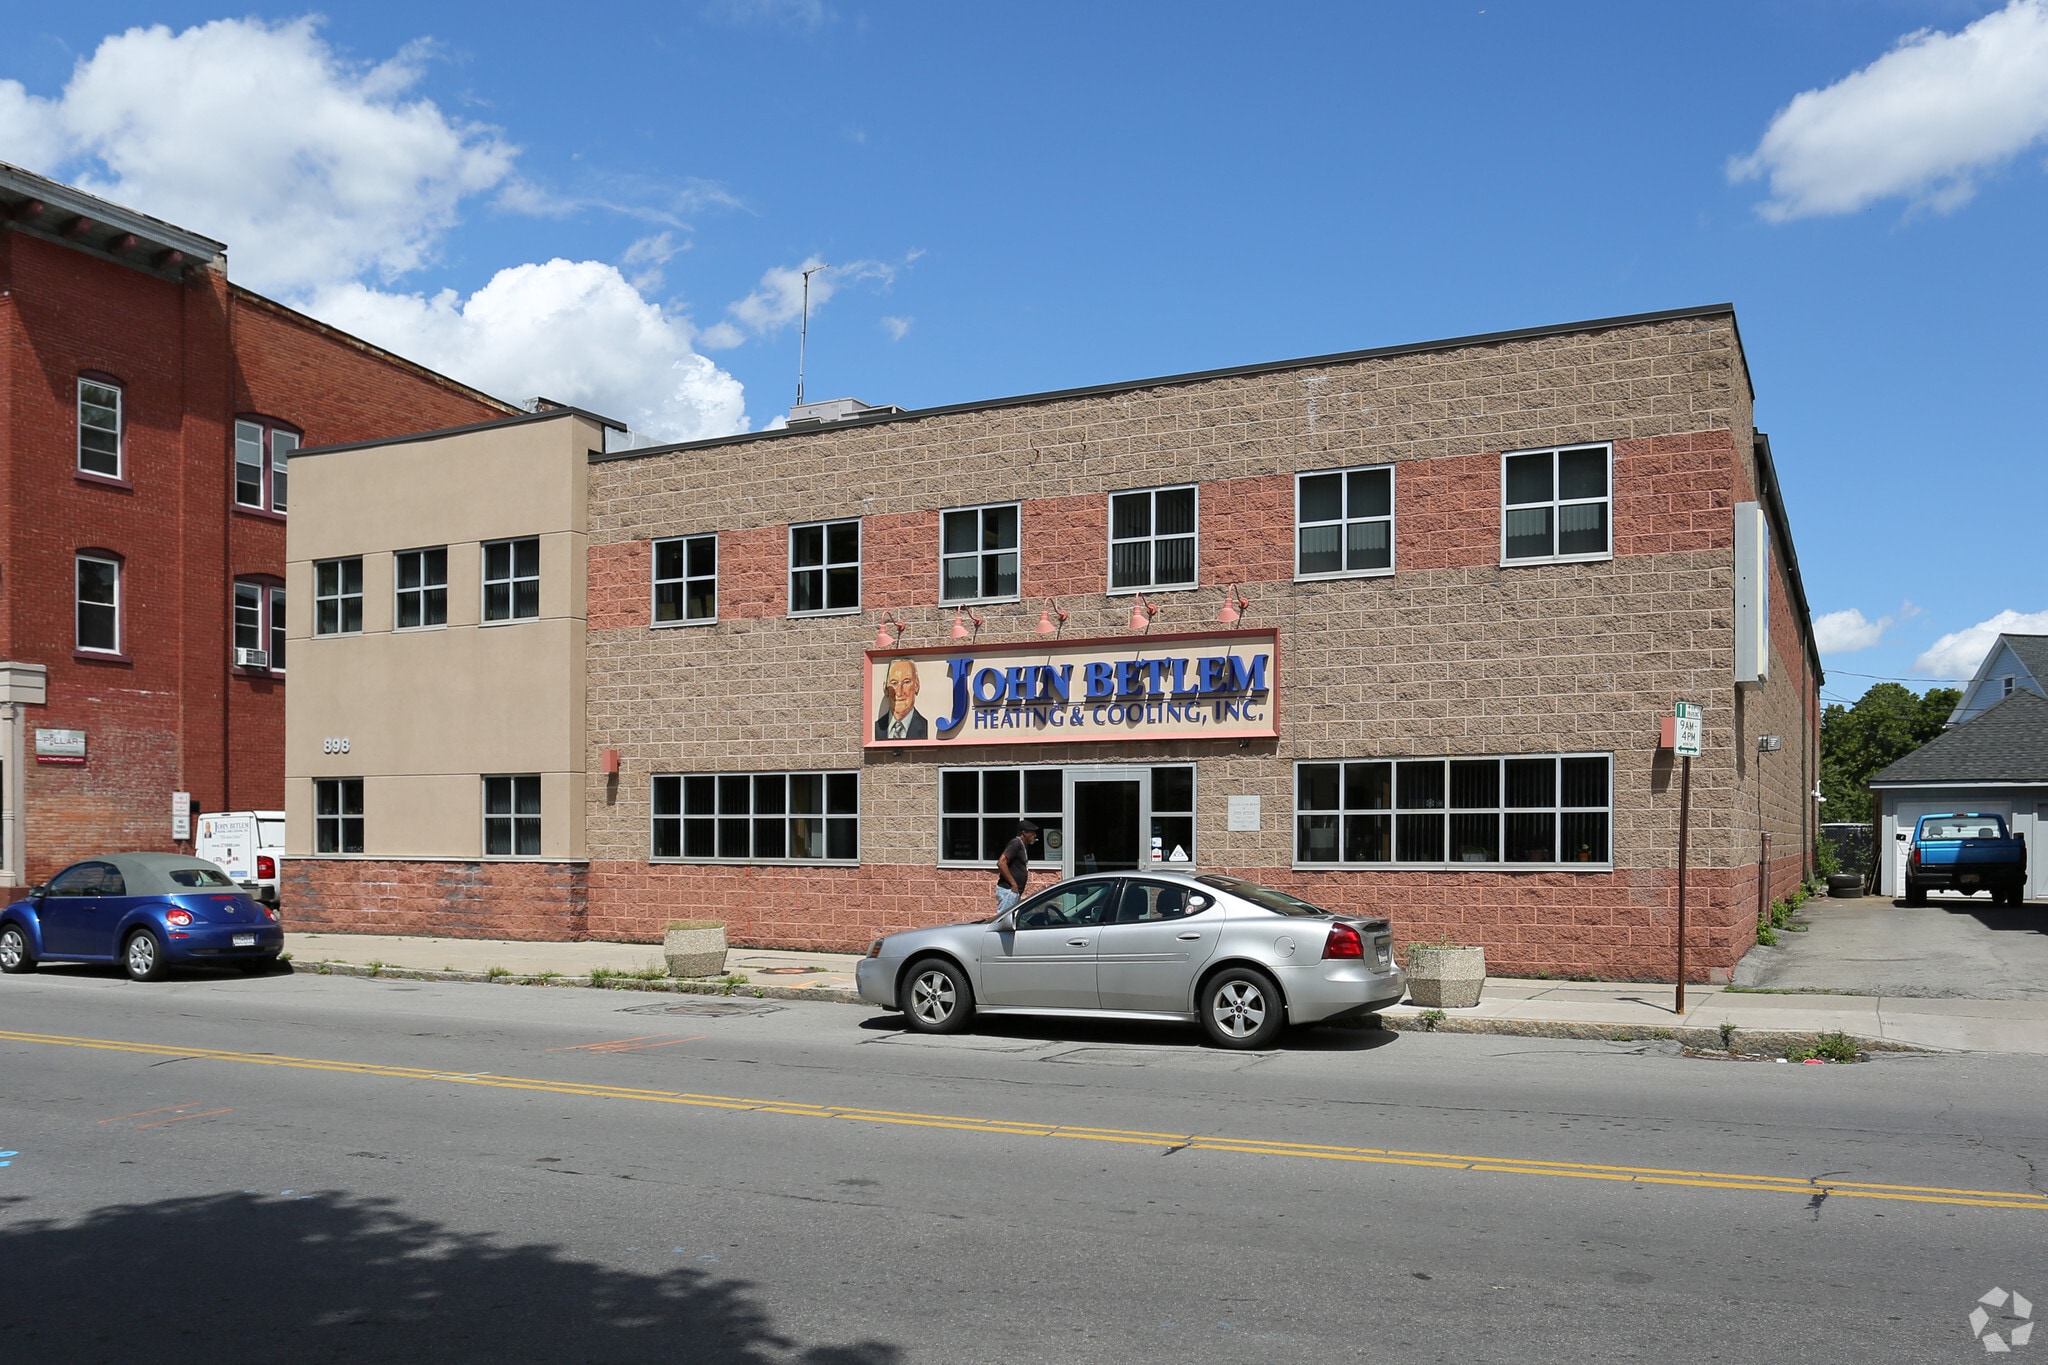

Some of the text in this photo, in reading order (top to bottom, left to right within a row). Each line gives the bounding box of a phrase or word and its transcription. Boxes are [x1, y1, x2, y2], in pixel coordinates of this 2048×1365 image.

[936, 654, 1269, 731] JOHN BETLEM
[974, 699, 1264, 729] HEATING & COOLING, INC.
[323, 738, 350, 752] 898
[1681, 731, 1696, 741] 4PM
